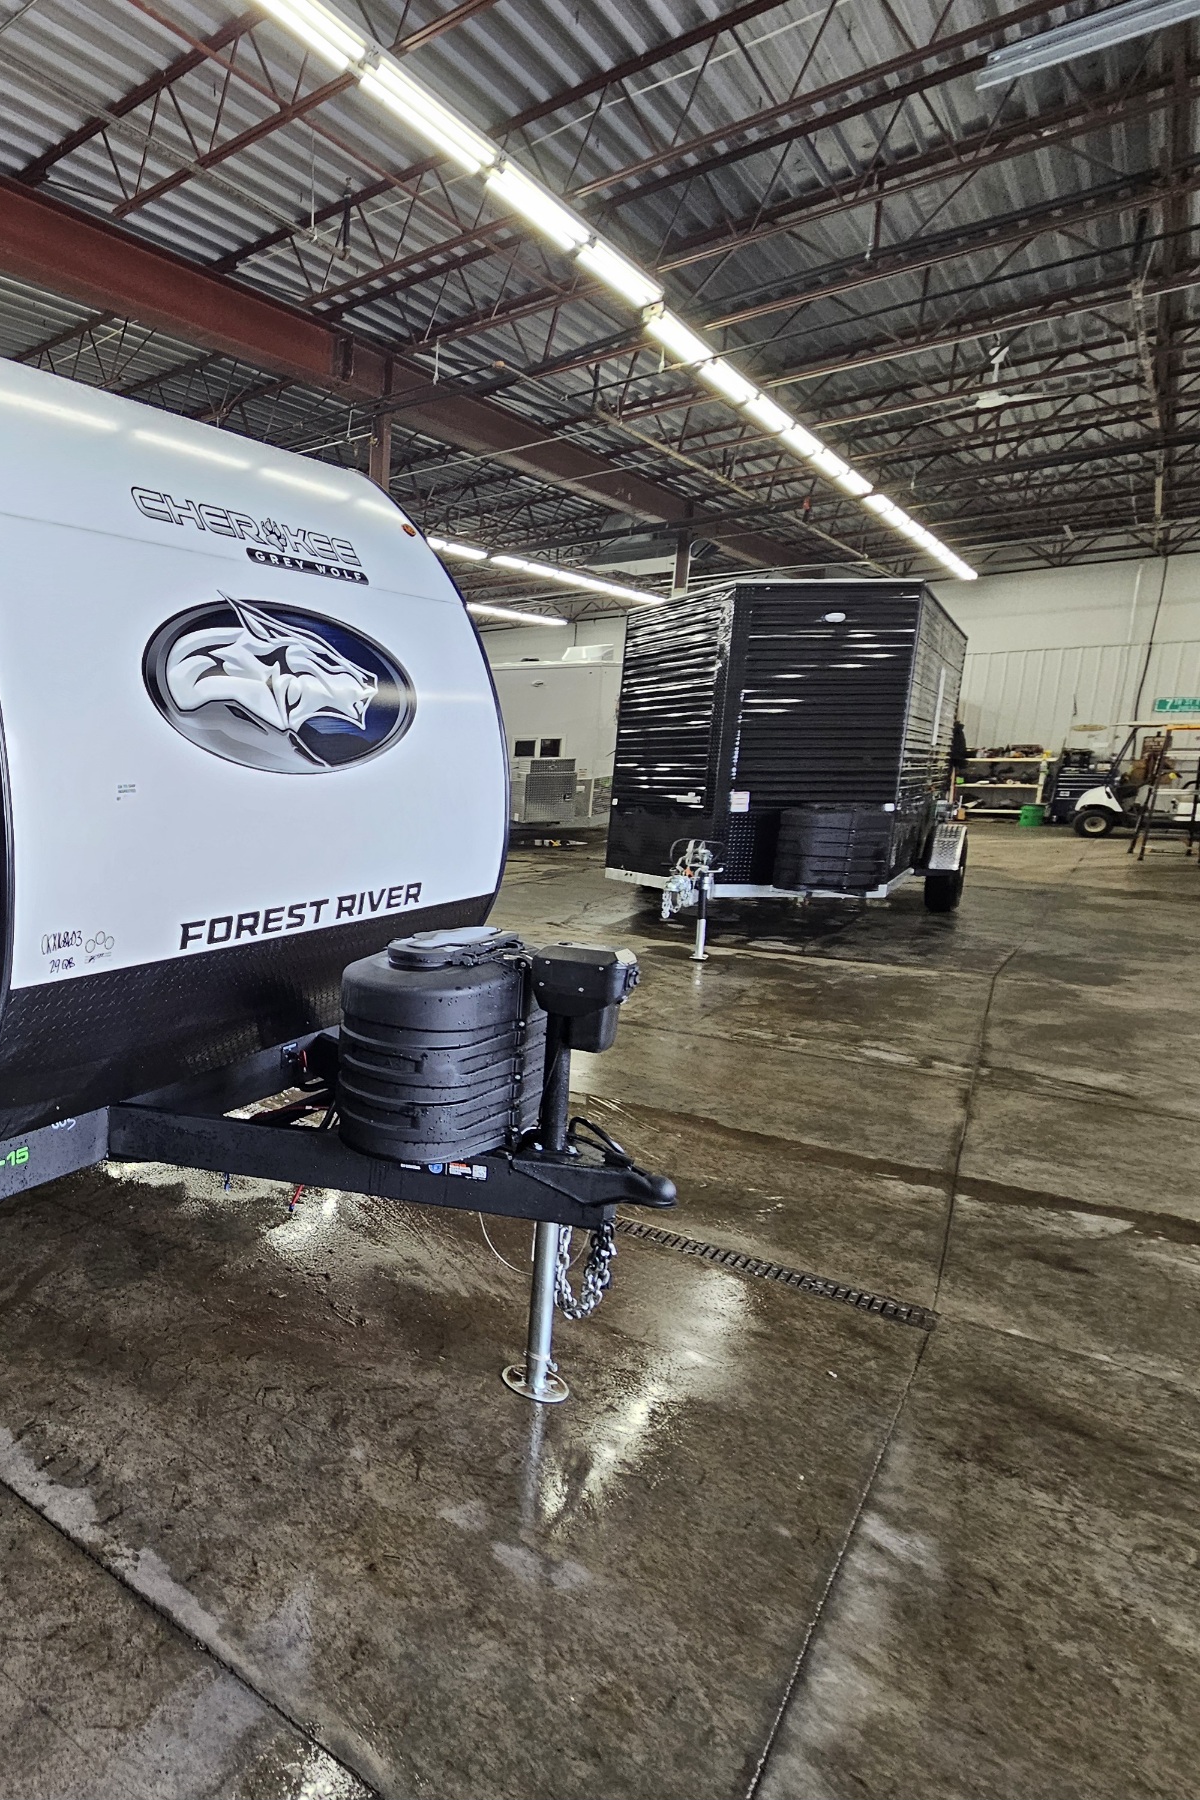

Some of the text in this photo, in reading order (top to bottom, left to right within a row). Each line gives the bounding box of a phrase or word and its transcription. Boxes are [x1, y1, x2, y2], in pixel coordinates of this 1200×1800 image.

[131, 486, 362, 567] CHEROKEE
[255, 551, 362, 581] GREY WOLF
[179, 882, 422, 950] FOREST RIVER
